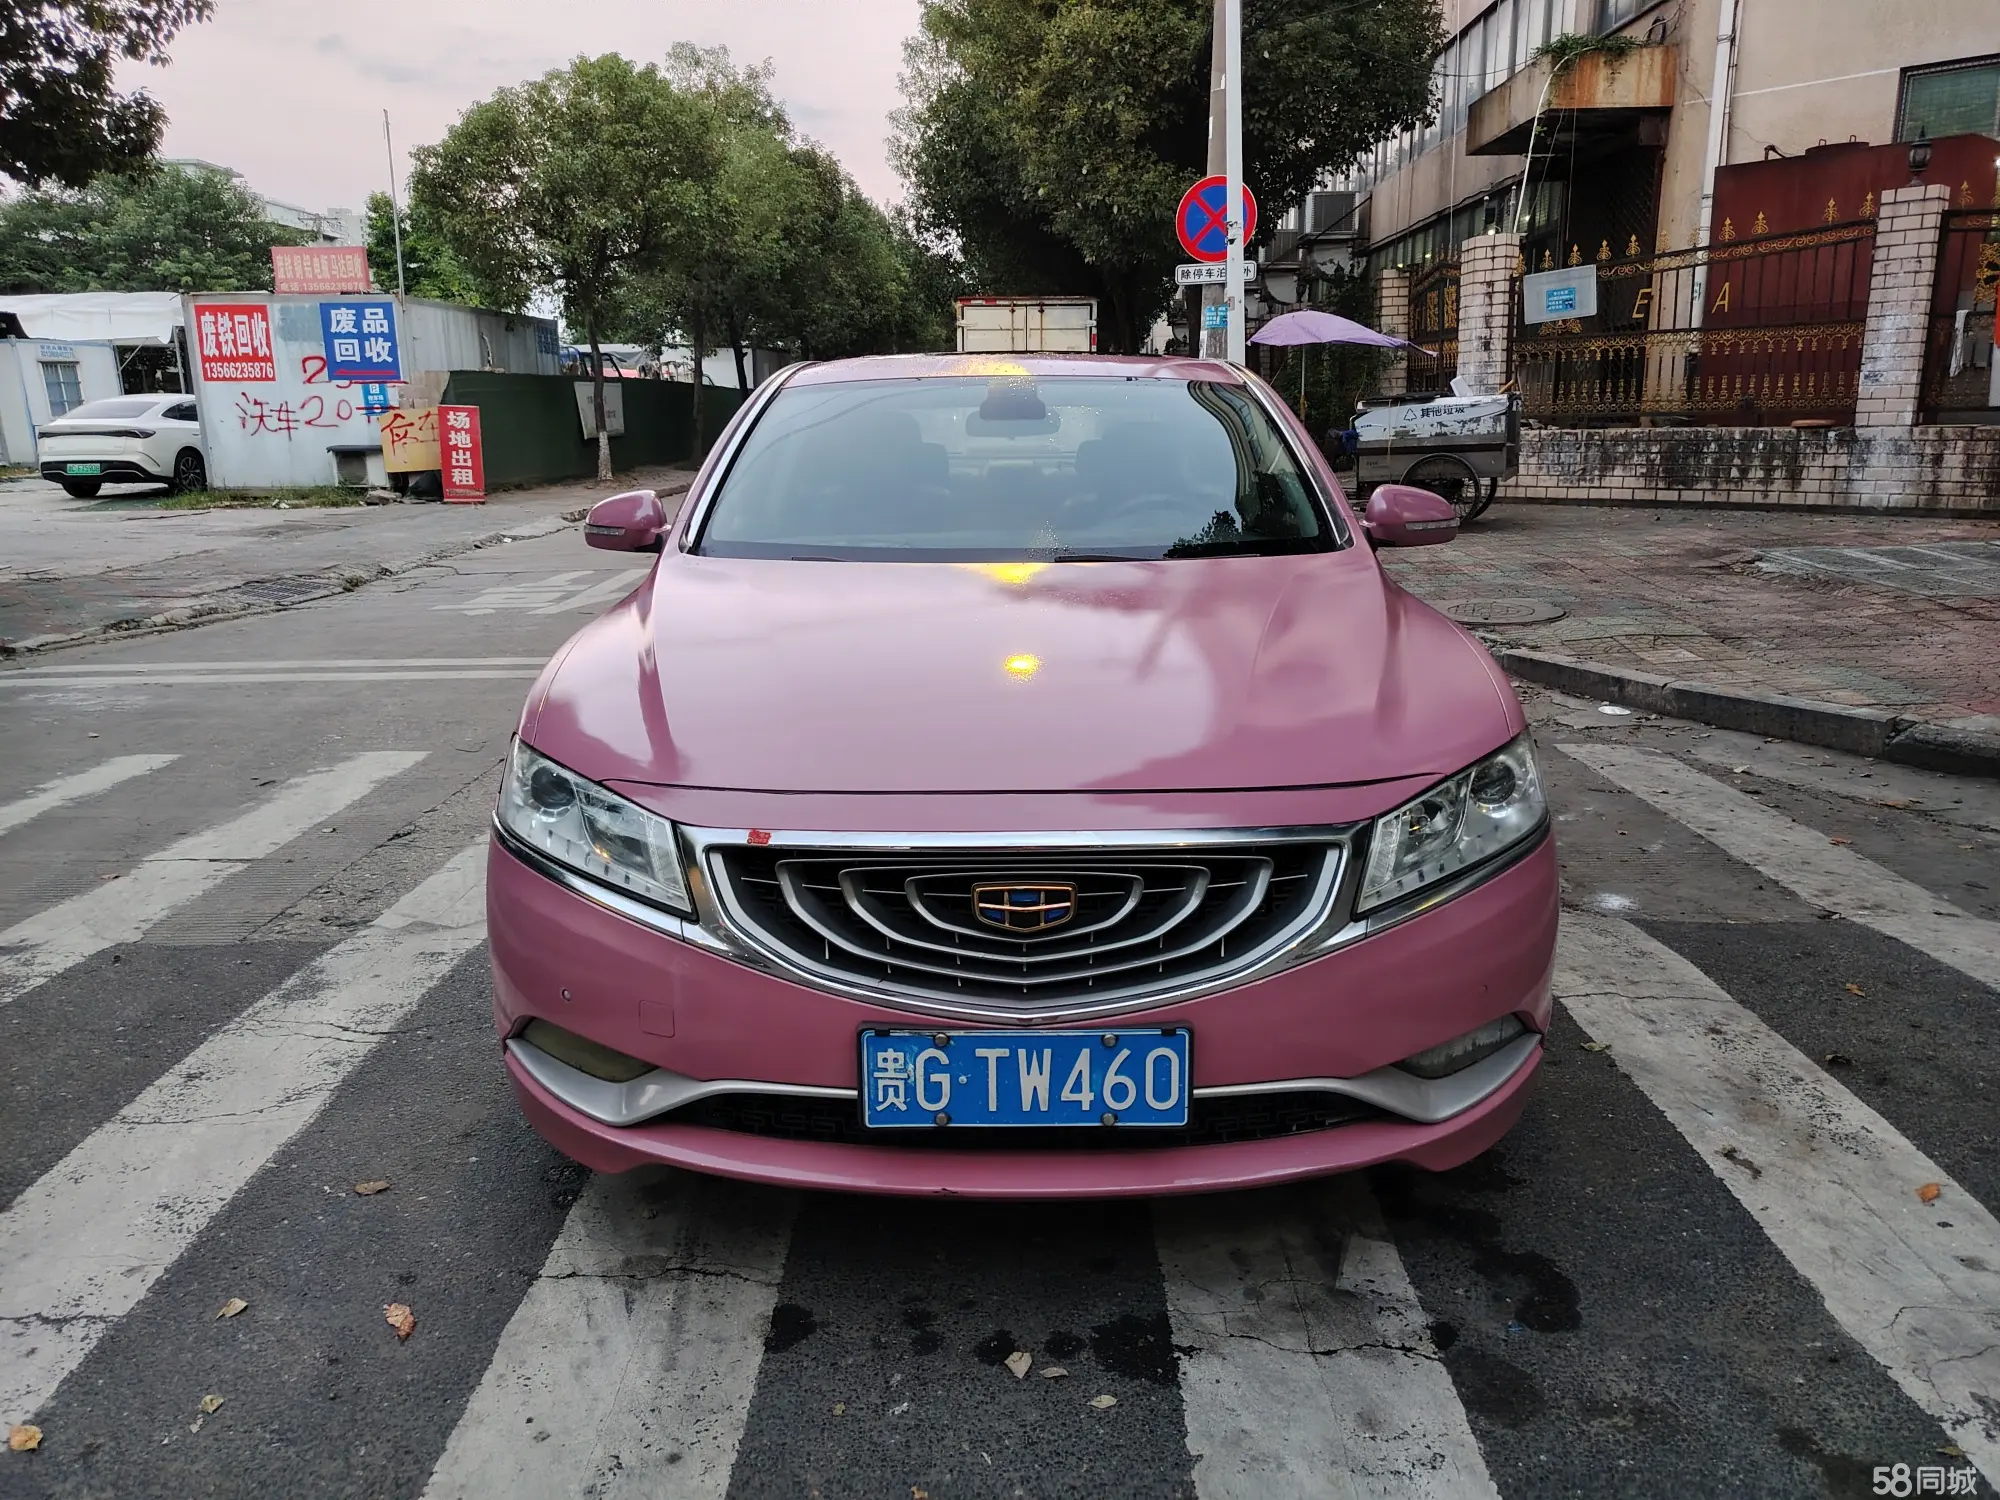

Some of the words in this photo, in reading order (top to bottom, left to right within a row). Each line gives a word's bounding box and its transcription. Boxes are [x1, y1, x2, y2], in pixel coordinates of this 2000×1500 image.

[1181, 266, 1252, 280] 除停车泊外
[1711, 282, 1729, 314] A
[330, 307, 389, 334] 废品
[201, 311, 269, 358] 废铁回收
[333, 337, 393, 363] 回收
[205, 362, 274, 378] 13566235876
[446, 411, 475, 486] 场地出租
